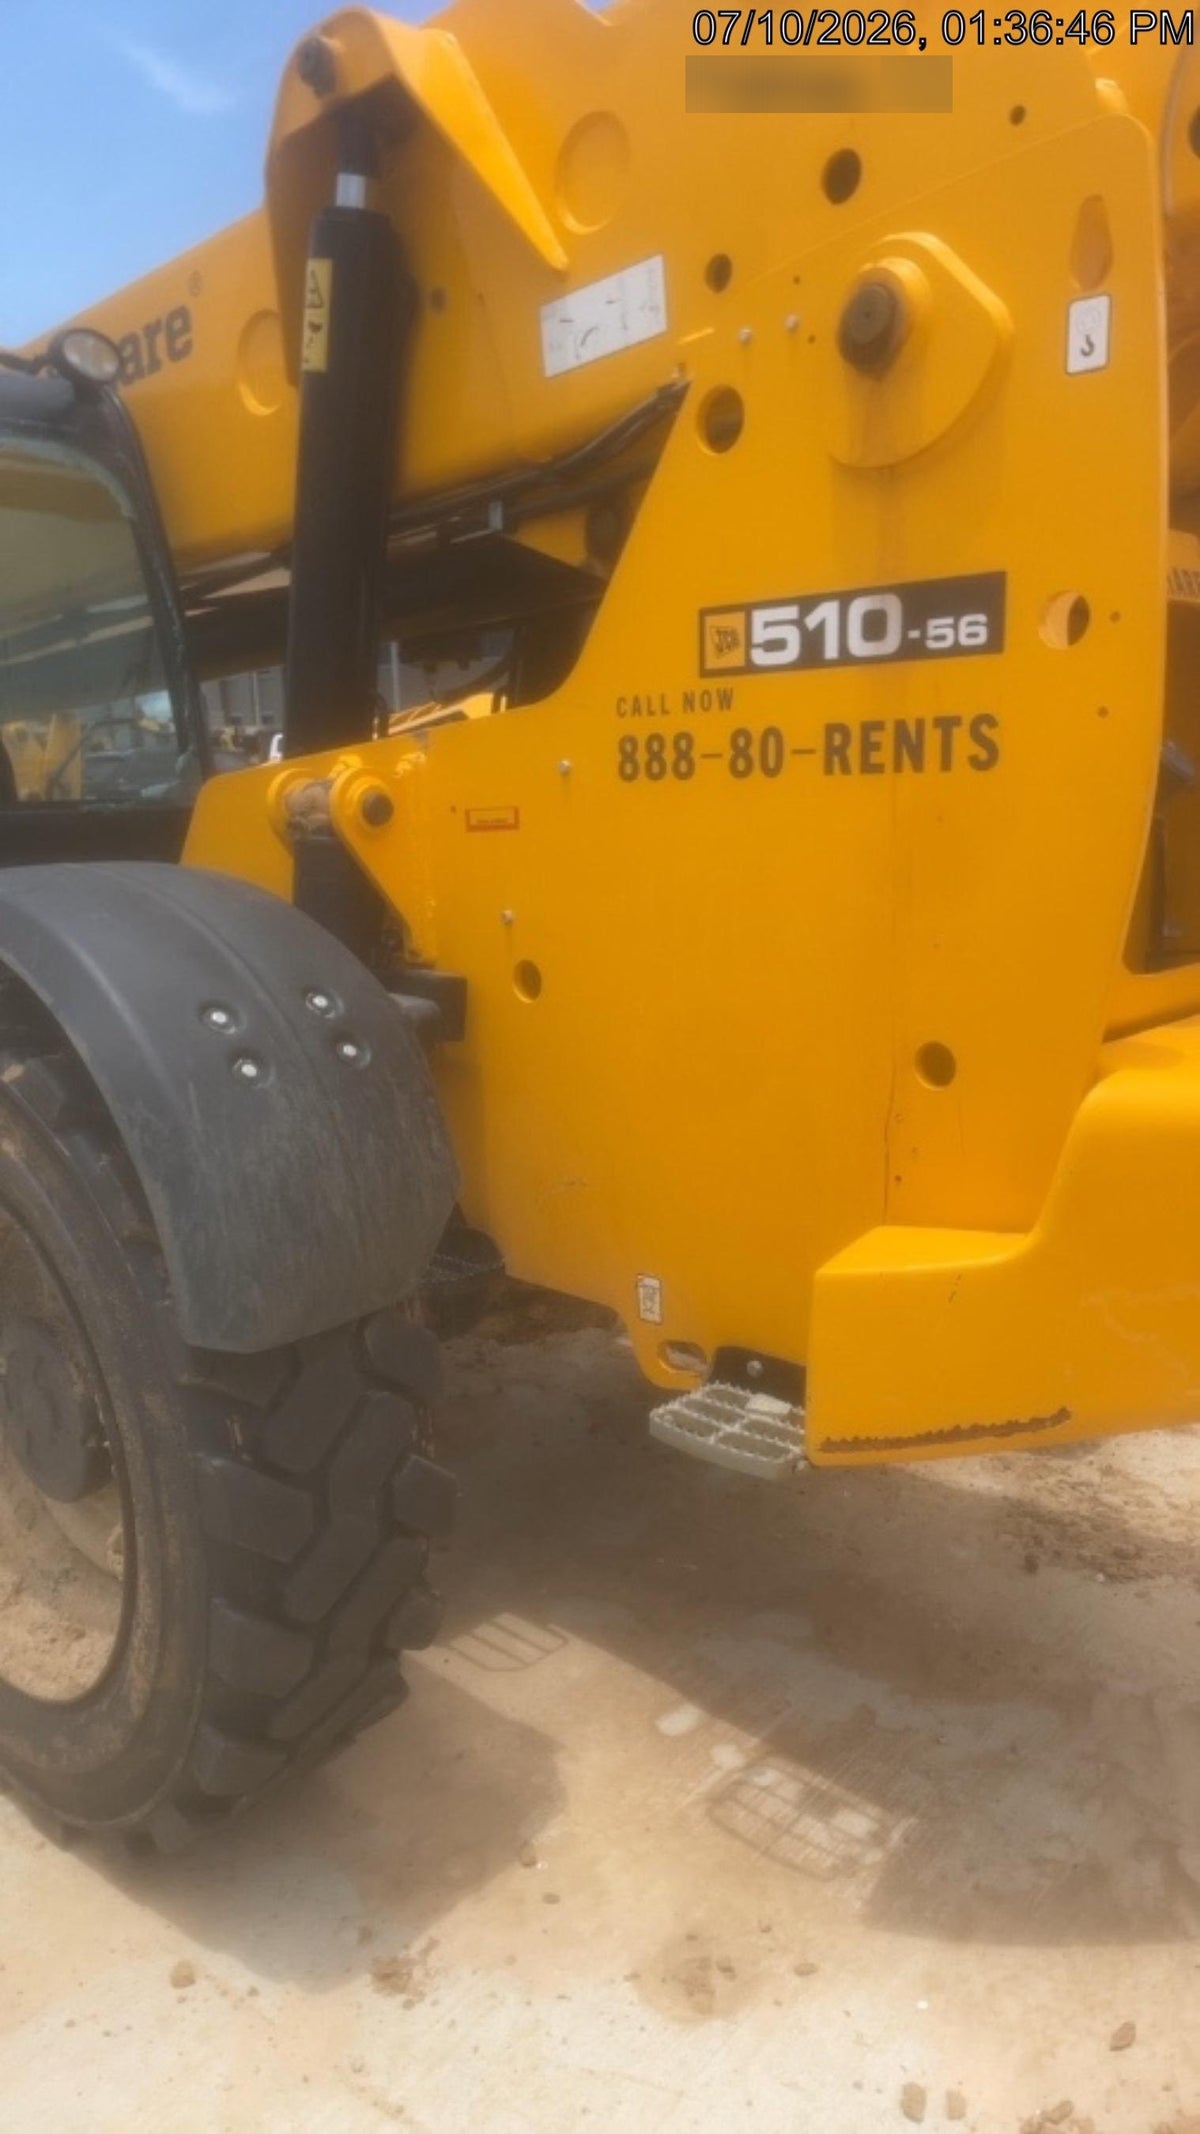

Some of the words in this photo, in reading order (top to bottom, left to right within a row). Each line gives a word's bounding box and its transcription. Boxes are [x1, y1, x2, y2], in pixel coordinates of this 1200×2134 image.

[750, 593, 989, 667] 510-56
[616, 691, 671, 719] CALL
[682, 687, 735, 715] NOW
[617, 712, 1001, 783] 888-80-RENTS
